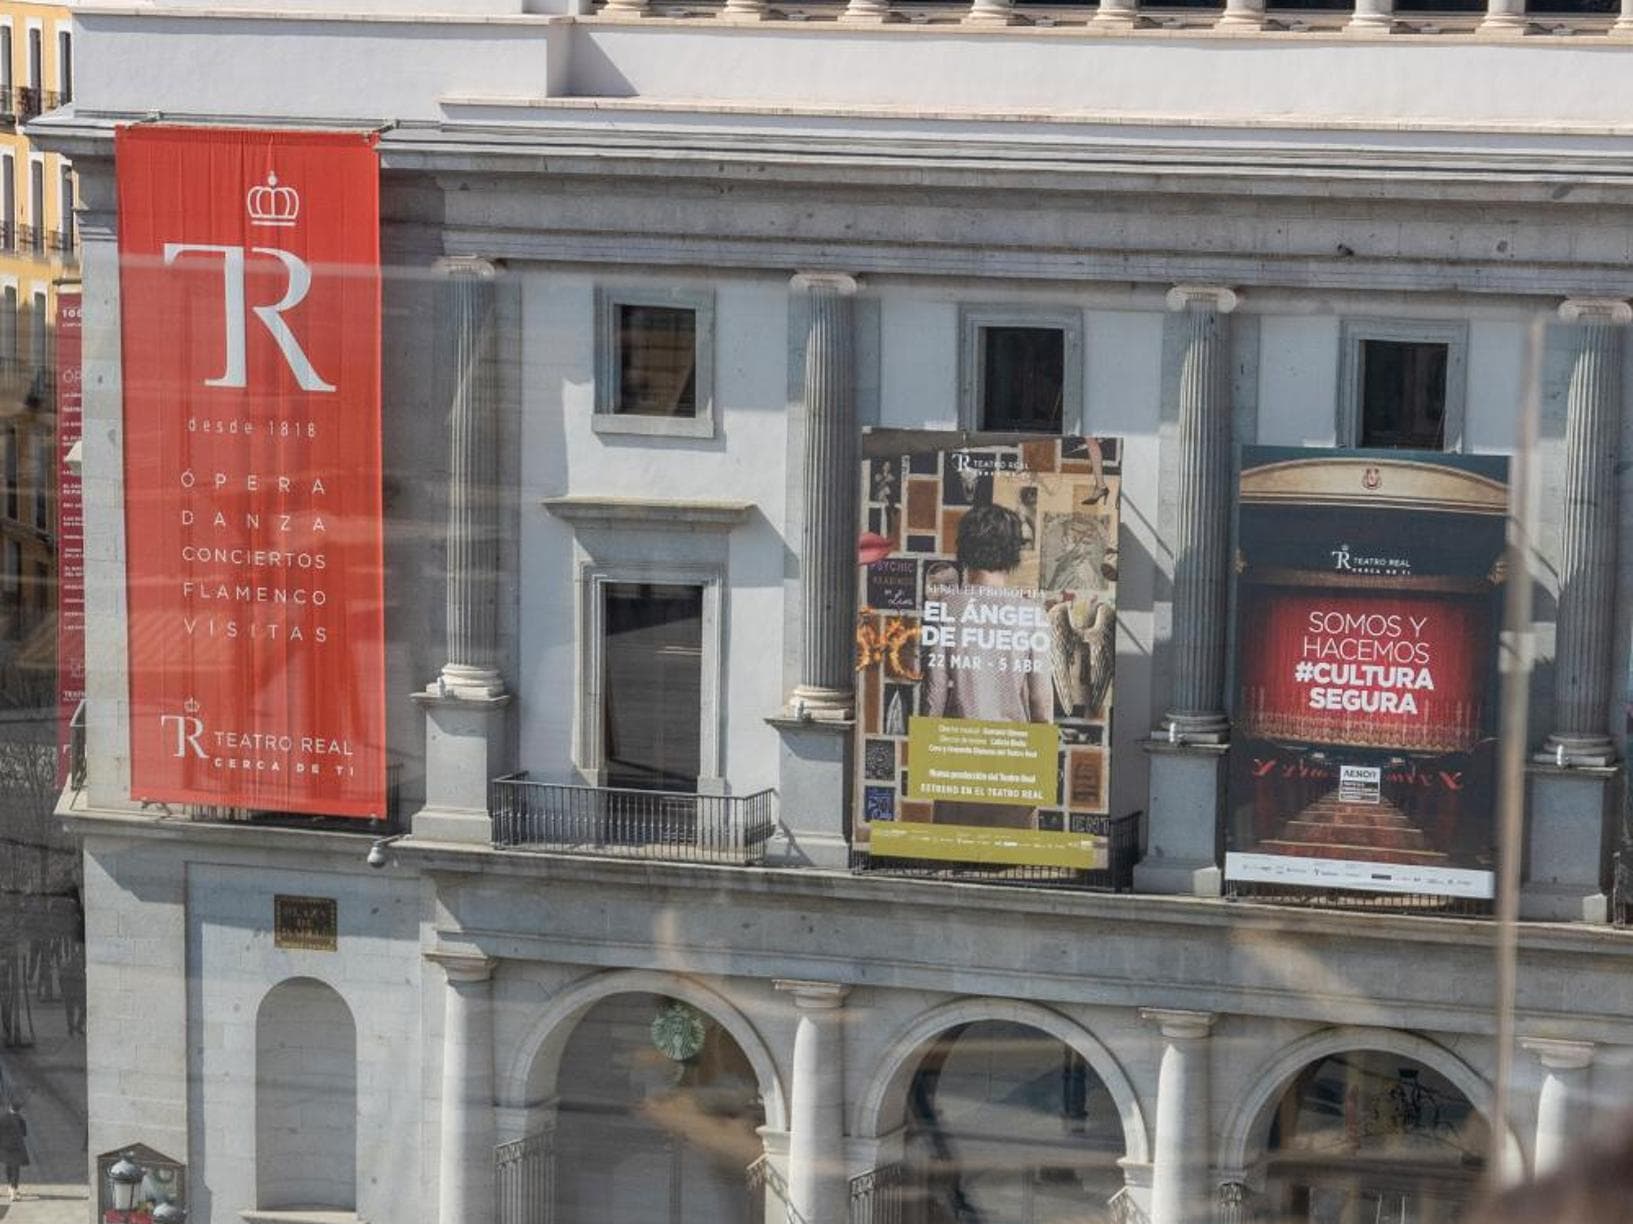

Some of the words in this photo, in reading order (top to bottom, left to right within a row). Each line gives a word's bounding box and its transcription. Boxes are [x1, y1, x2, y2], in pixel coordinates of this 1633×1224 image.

[164, 243, 336, 392] TR
[188, 418, 254, 434] desde
[269, 420, 315, 438] 1818
[181, 468, 325, 495] ÓPERA
[182, 510, 325, 532] DANZA
[182, 546, 326, 569] CONCIERTOS
[1332, 551, 1351, 569] TR
[183, 582, 326, 605] FLAMENCO
[924, 601, 955, 623] EL
[961, 598, 1049, 627] ÁNGEL
[1309, 611, 1401, 637] SOMOS
[1410, 616, 1427, 638] Y
[184, 617, 327, 642] VISITAS
[922, 625, 956, 648] DE
[962, 627, 1051, 651] FUEGO
[1303, 636, 1430, 664] HACEMOS
[928, 653, 945, 668] 22
[951, 654, 981, 670] MAR
[999, 657, 1007, 671] 5
[1014, 658, 1042, 674] ABR
[1295, 662, 1434, 690] #CULTURA
[1309, 688, 1418, 714] SEGURA
[161, 715, 209, 759] TR
[214, 731, 292, 750] TEATRO
[301, 737, 353, 755] REAL
[214, 758, 280, 771] CERCA
[296, 762, 320, 773] DE
[336, 765, 354, 776] TI
